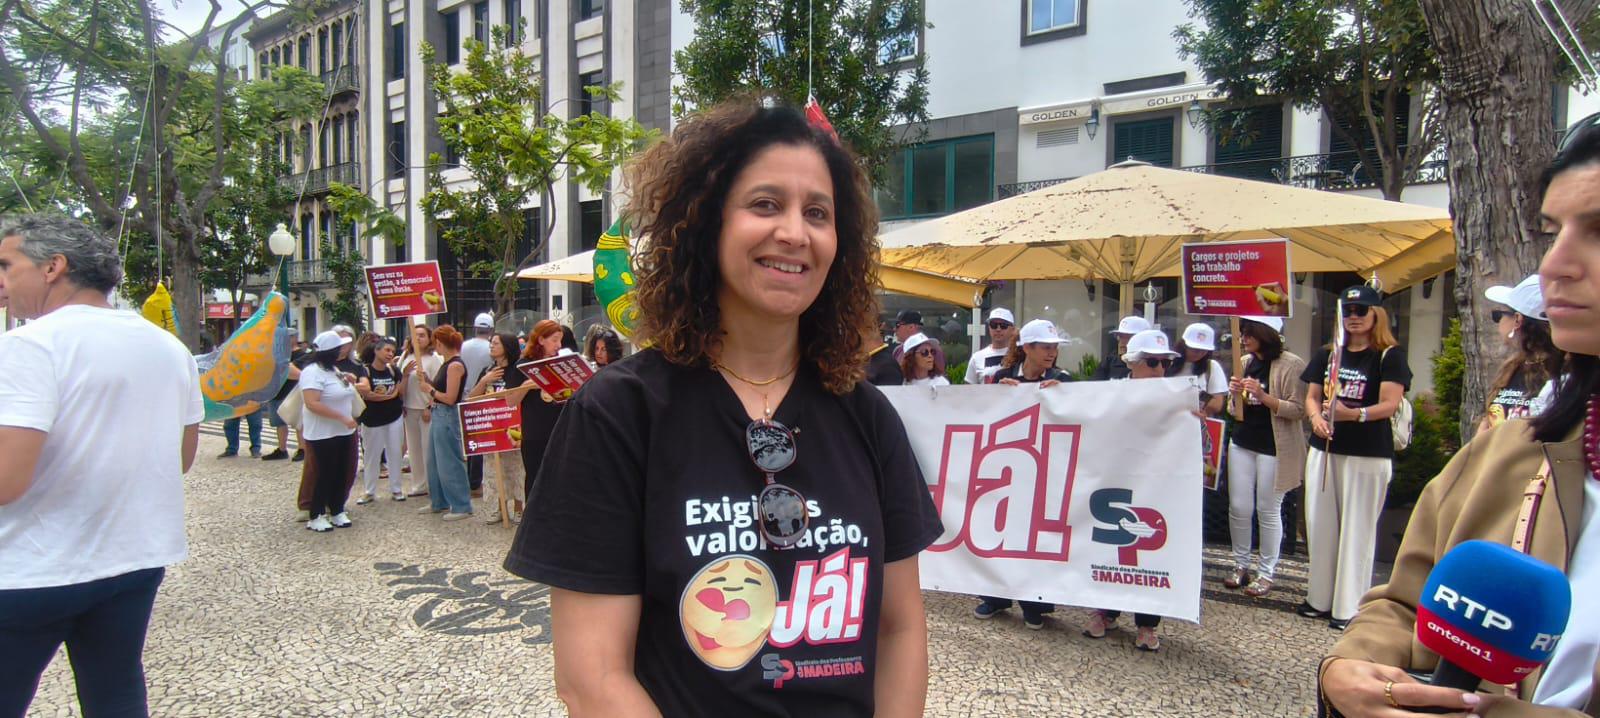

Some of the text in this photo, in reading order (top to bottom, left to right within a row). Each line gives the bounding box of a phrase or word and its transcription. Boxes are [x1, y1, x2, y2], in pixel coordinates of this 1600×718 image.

[1147, 93, 1199, 107] GOLDEN
[1032, 109, 1077, 122] GOLDEN
[1191, 251, 1216, 263] Cargos
[1225, 250, 1259, 261] projetos
[1192, 262, 1240, 272] são trabalho
[401, 275, 433, 285] democracia
[1193, 273, 1228, 282] concreto.
[926, 403, 1082, 562] Já!
[685, 495, 822, 528] Exigis
[1089, 487, 1168, 567] SP
[685, 518, 868, 556] valoação,
[1099, 571, 1171, 589] MADEIRA
[767, 545, 869, 648] Já!
[1433, 584, 1513, 631] RTP
[760, 653, 795, 688] SP
[804, 661, 865, 678] MADEIRA
